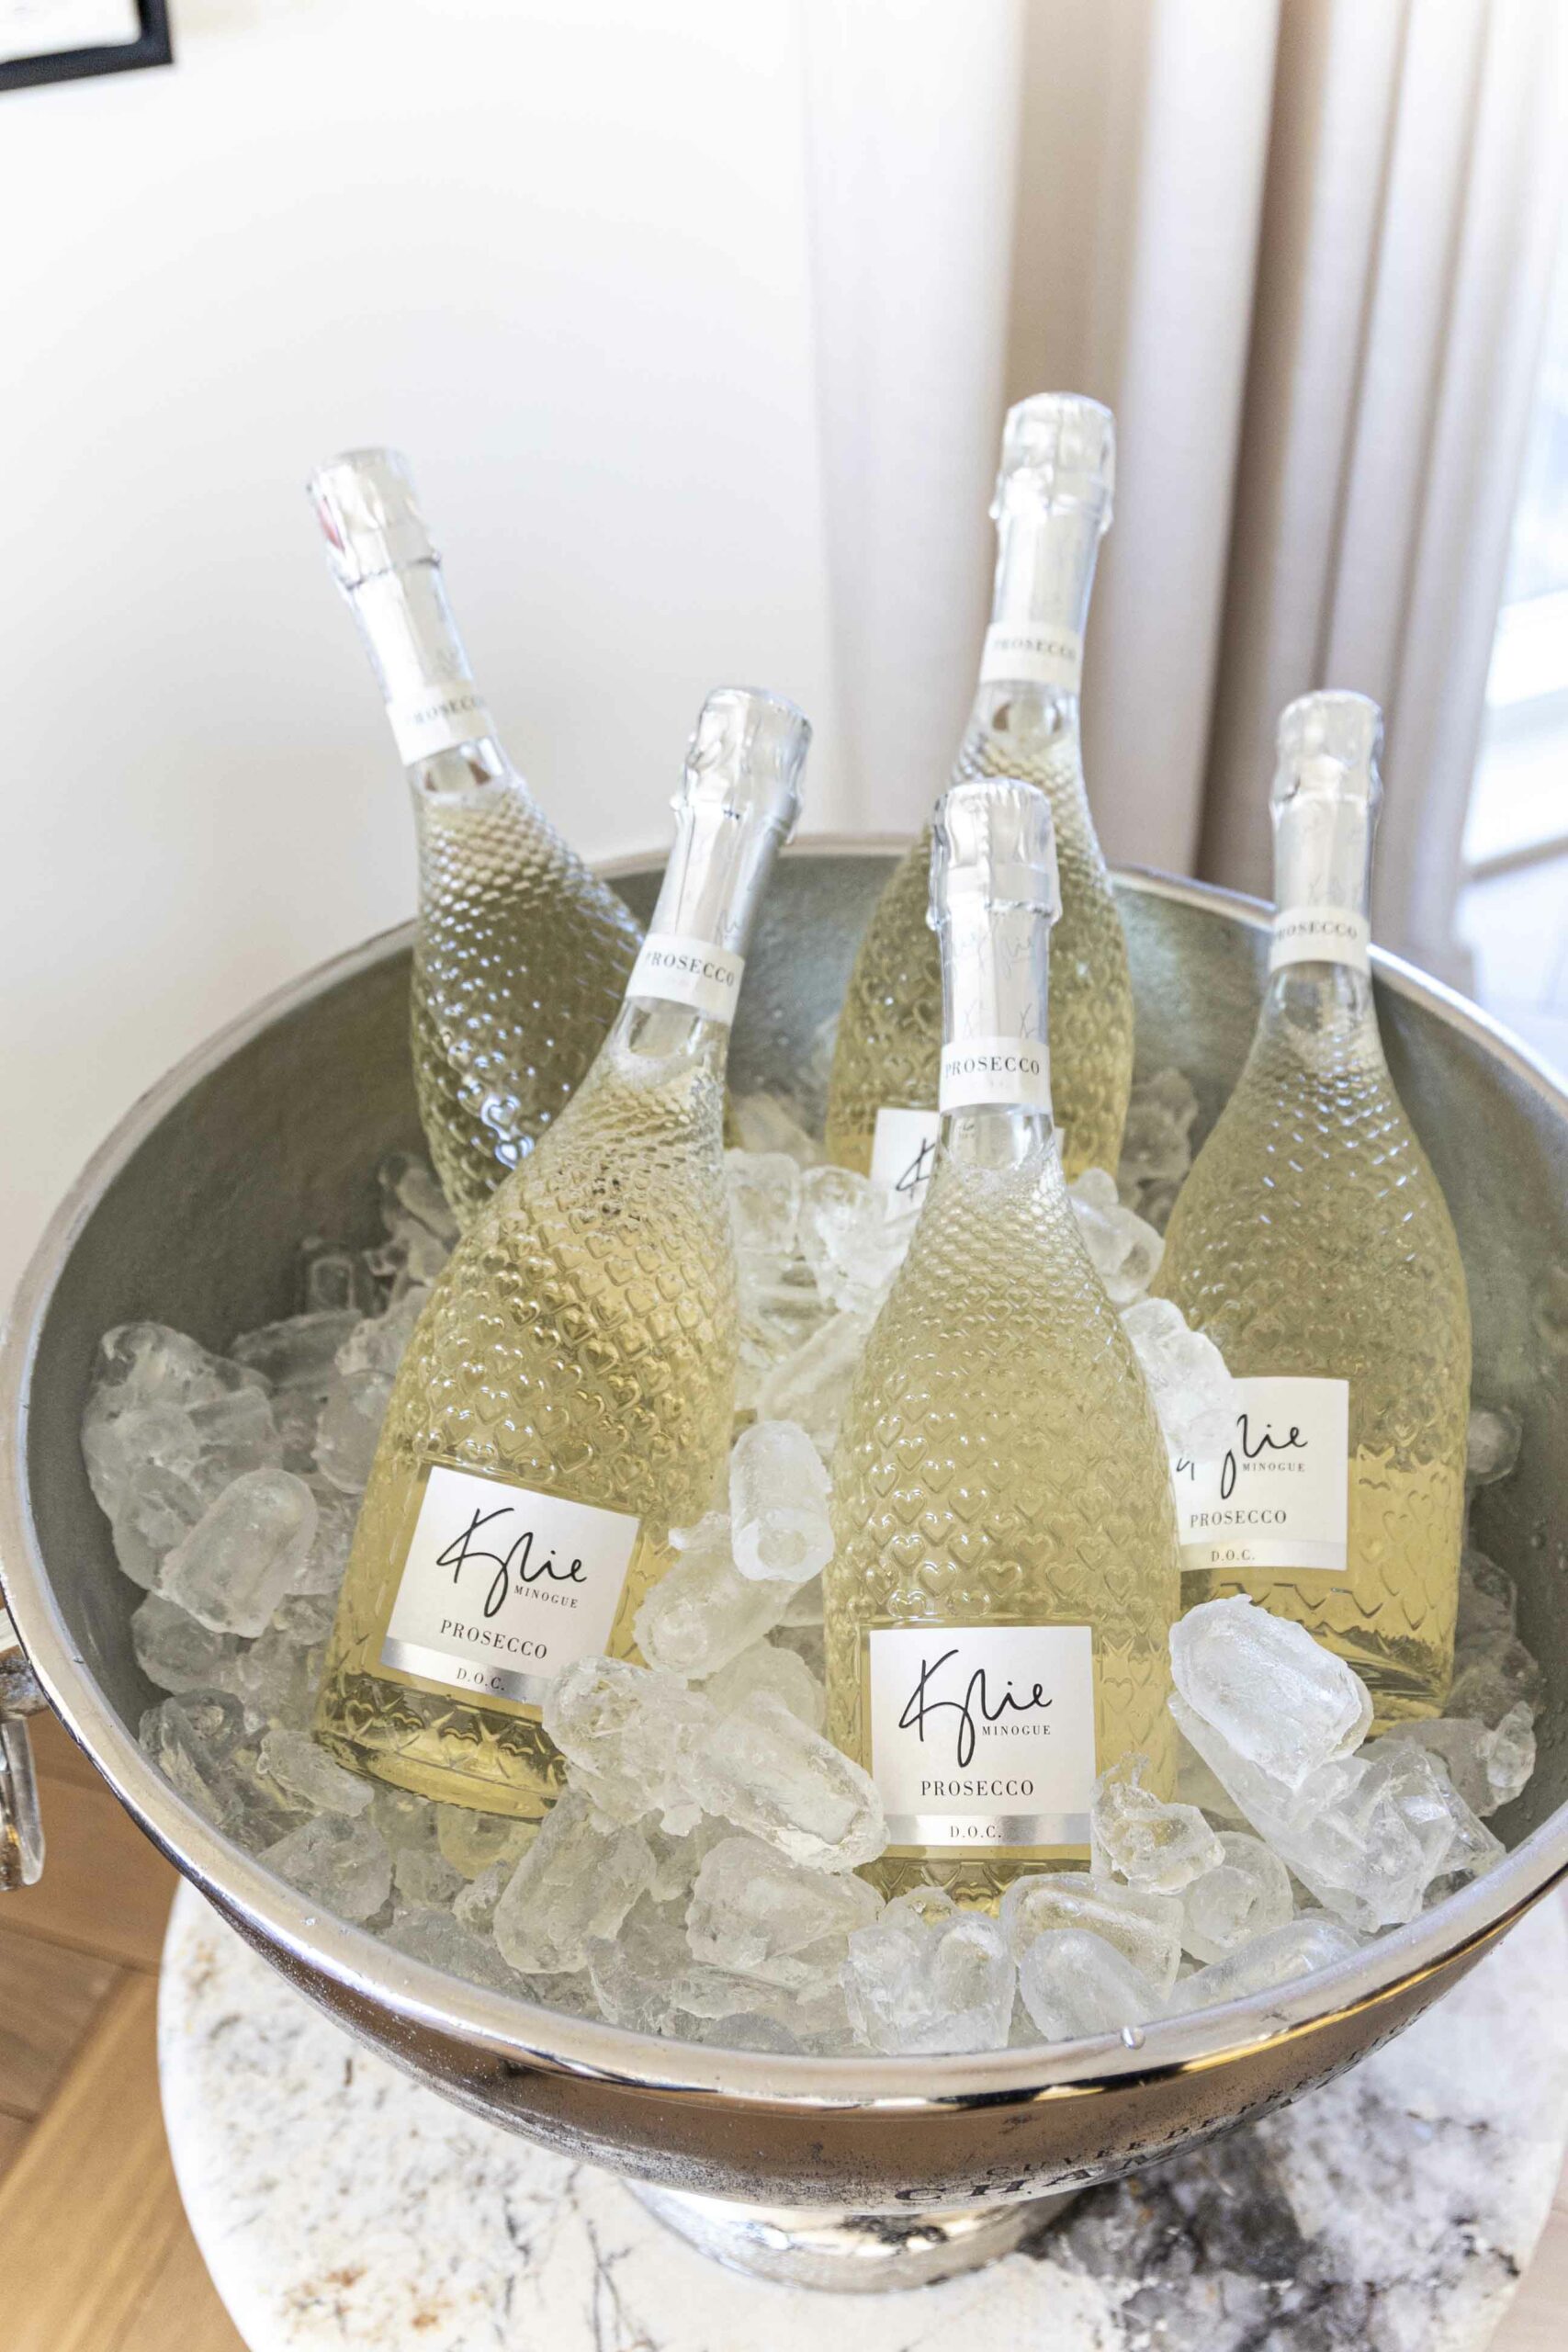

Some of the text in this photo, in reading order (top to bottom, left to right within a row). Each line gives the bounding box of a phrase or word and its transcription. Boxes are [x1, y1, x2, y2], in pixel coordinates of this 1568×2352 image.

[406, 695, 484, 724] ROSECC
[944, 1057, 1040, 1079] PROSECCO
[1176, 1413, 1309, 1500] ylie
[1242, 1463, 1306, 1474] MINOGUE
[1190, 1510, 1288, 1529] PROSECCO
[435, 1507, 588, 1619] Kylie
[1211, 1549, 1256, 1562] D.O.C.
[513, 1584, 579, 1609] MINOGUE
[440, 1618, 547, 1660] PROSECCO
[456, 1667, 505, 1691] D.O.C.
[898, 1648, 1054, 1769] Kylie
[982, 1724, 1052, 1736] MINOGUE
[920, 1780, 1034, 1796] PROSECCO
[950, 1825, 1002, 1838] D.O.C.
